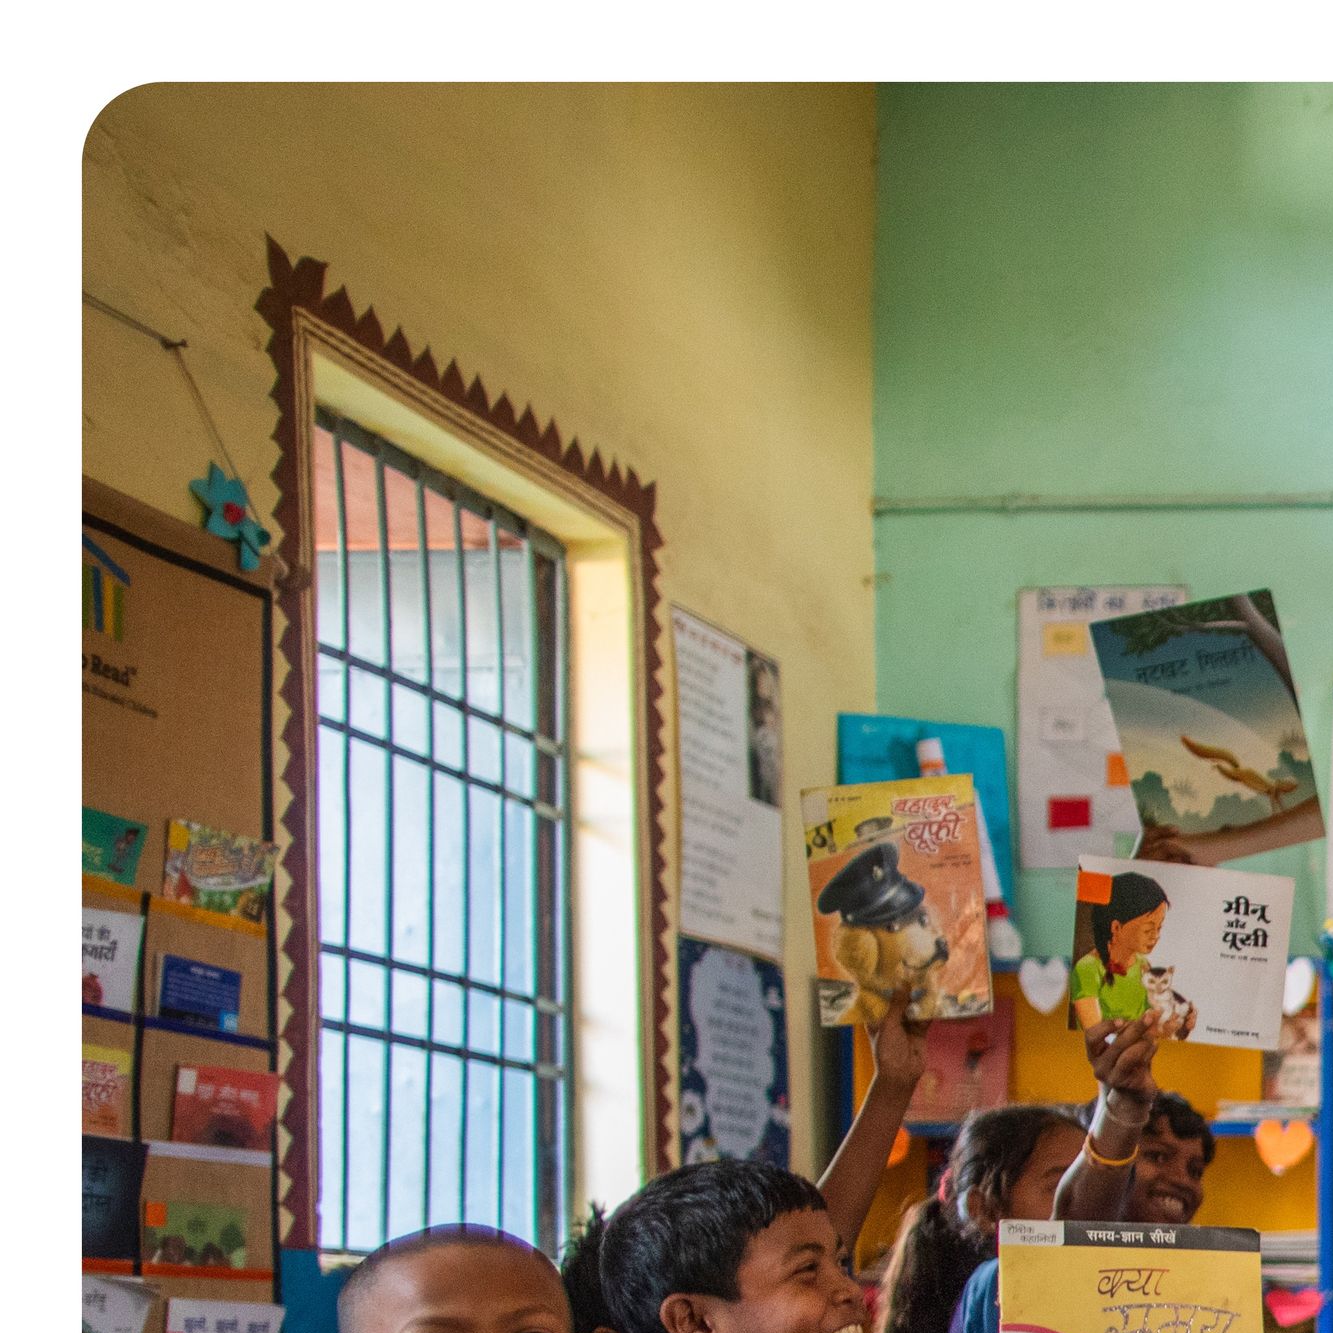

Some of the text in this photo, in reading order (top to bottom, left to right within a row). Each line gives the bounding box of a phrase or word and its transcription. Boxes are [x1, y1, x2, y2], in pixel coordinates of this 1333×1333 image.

[1223, 895, 1271, 924] मीनू
[1222, 927, 1269, 951] पूसी
[1085, 1228, 1177, 1245] समय-ज्ञान सीखें
[1097, 1267, 1170, 1299] क्या
